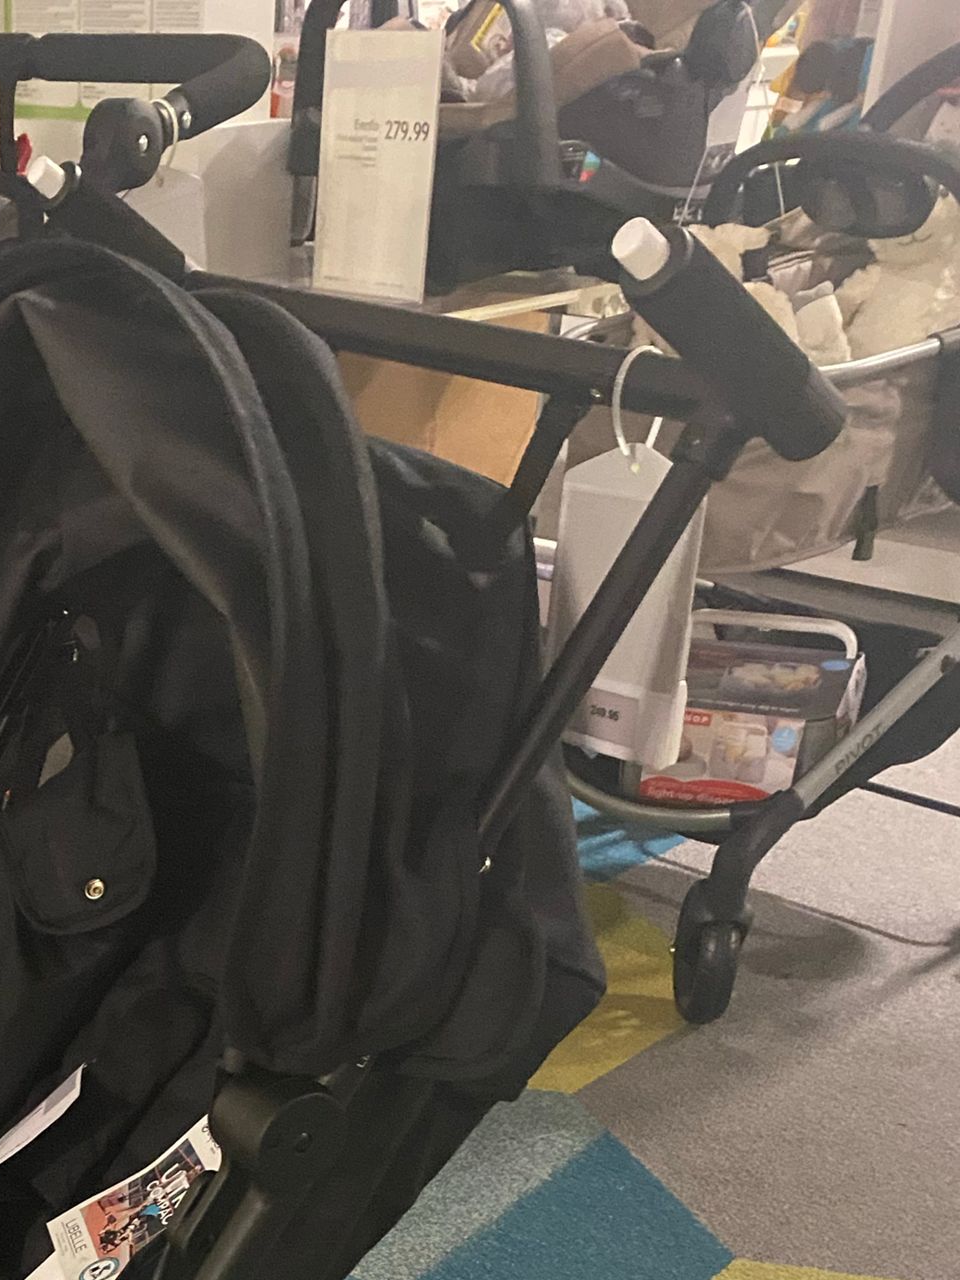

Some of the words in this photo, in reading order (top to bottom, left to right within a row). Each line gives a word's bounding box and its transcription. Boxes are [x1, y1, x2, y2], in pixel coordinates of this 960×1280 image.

[384, 119, 430, 142] 279.99
[834, 722, 884, 775] PIVOT
[146, 1180, 174, 1225] COMPAC
[65, 1218, 87, 1253] LIBELLE
